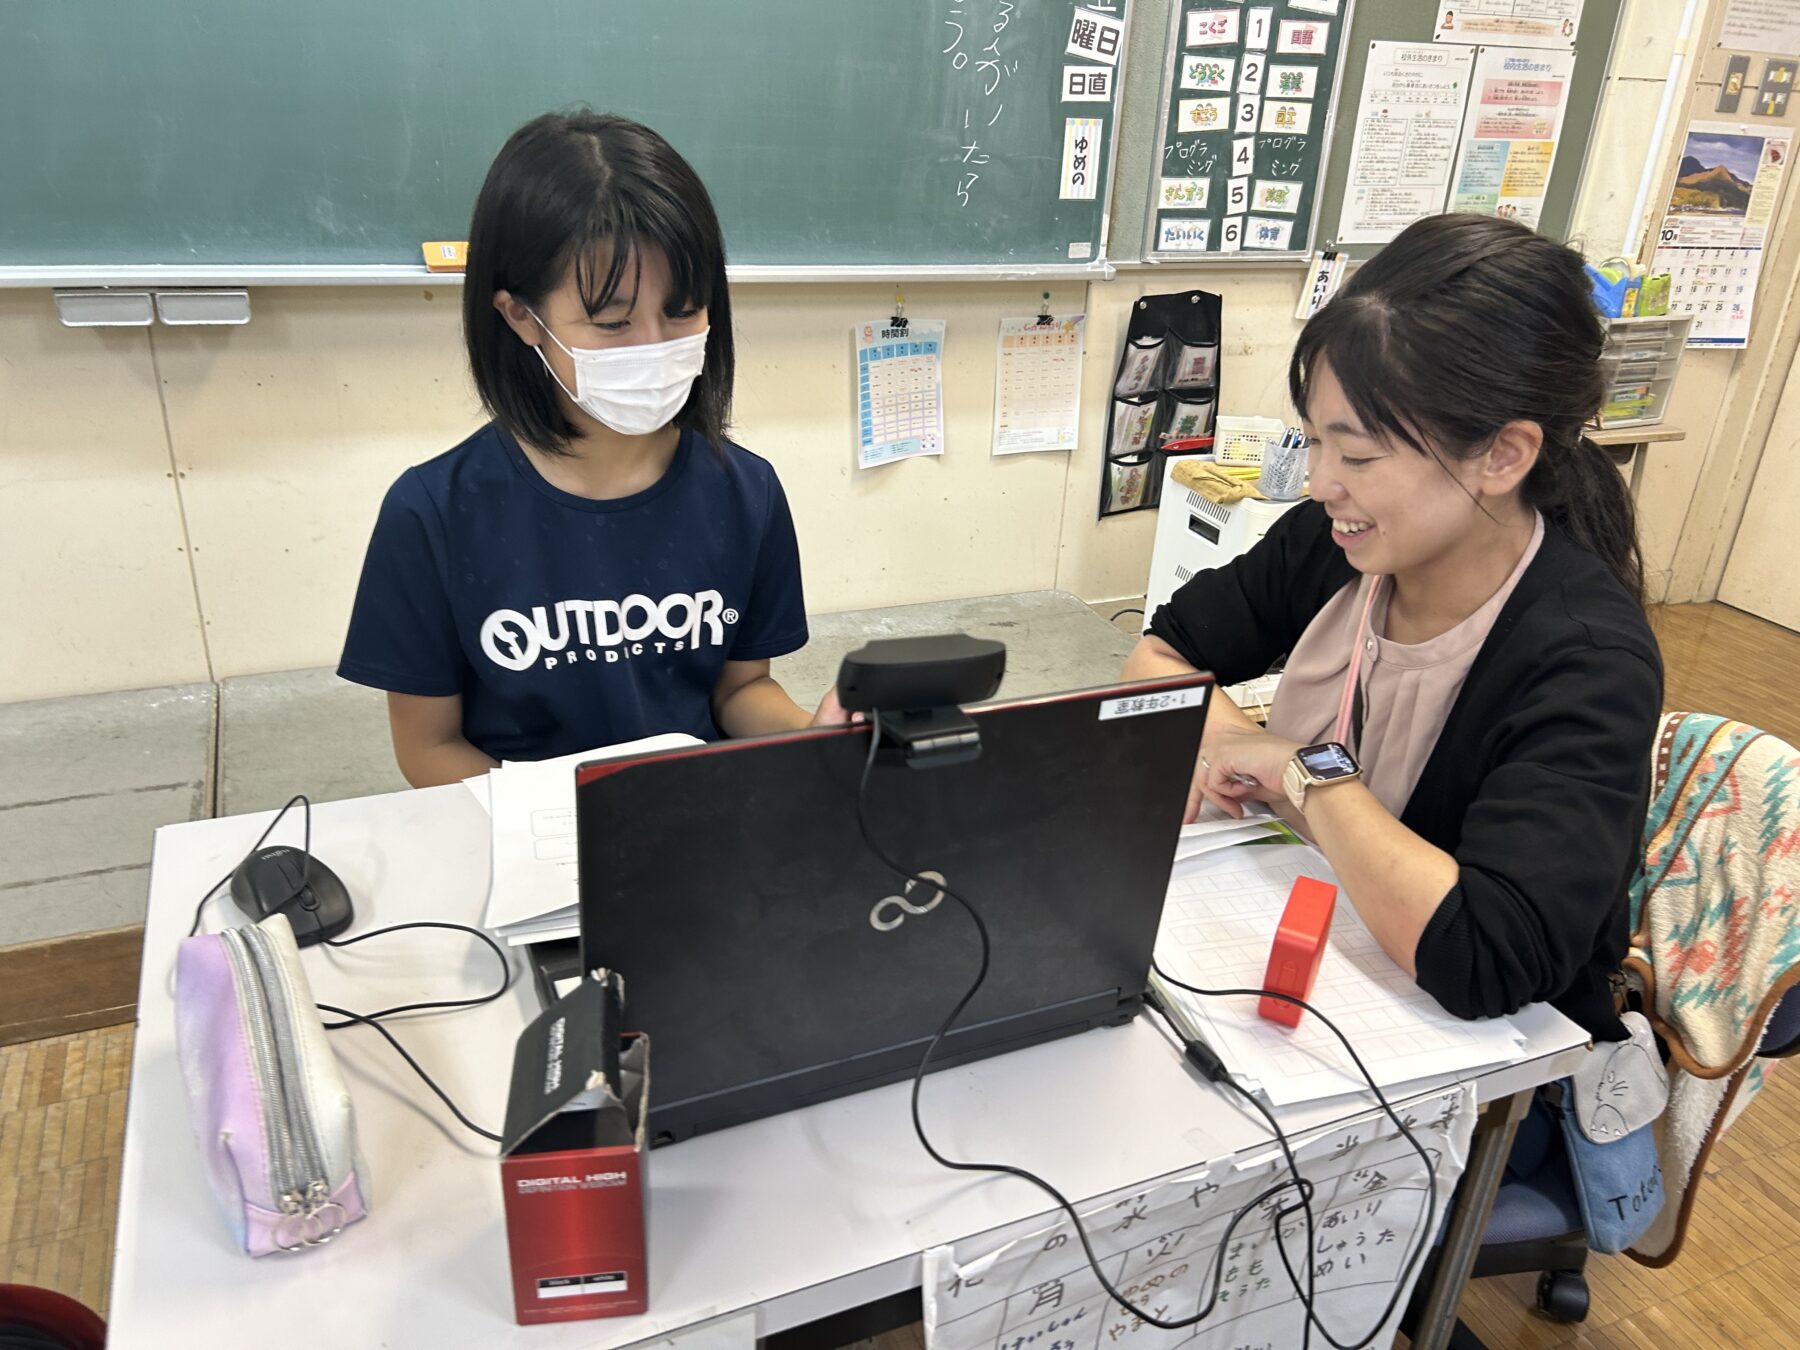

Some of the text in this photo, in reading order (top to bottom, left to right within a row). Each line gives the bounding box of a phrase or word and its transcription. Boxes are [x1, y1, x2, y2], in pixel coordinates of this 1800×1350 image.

[1199, 18, 1228, 35] こくご
[1256, 18, 1263, 38] 1
[1072, 19, 1120, 56] 曜日
[1244, 63, 1259, 82] 2
[1069, 72, 1108, 95] 日直
[1241, 103, 1254, 123] 3
[1165, 139, 1208, 159] プログラ
[1259, 136, 1306, 151] プログラ
[1072, 136, 1088, 186] ゆめの
[1237, 146, 1249, 164] 4
[1187, 154, 1217, 176] ミング
[1271, 157, 1302, 176] ミング
[1232, 186, 1243, 204] 5
[1225, 225, 1237, 242] 6
[1311, 270, 1330, 309] あいり
[881, 328, 909, 339] 時間割
[480, 589, 724, 671] OUTDOOR
[517, 1176, 581, 1187] DIGITAL
